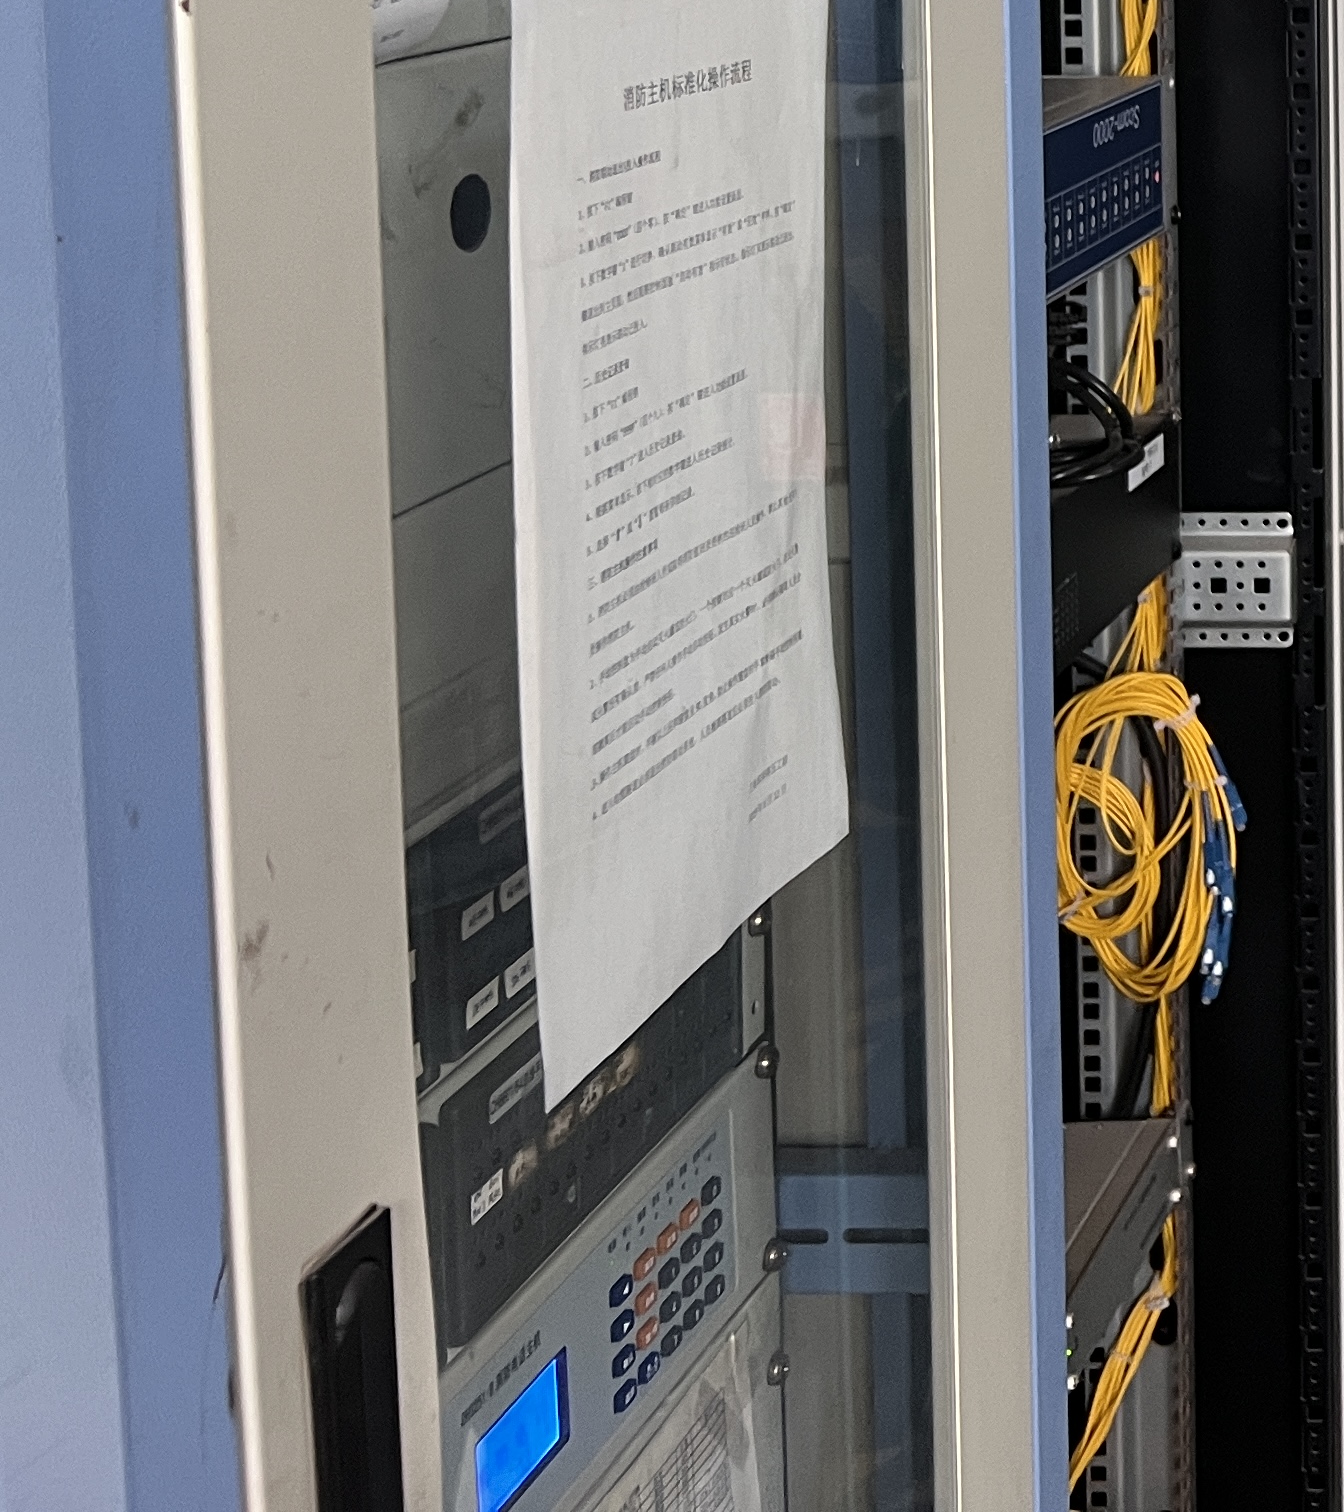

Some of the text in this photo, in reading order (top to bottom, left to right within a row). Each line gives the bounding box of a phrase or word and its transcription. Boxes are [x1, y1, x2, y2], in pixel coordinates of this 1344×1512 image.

[623, 58, 753, 112] 消防主机标准化操作流程
